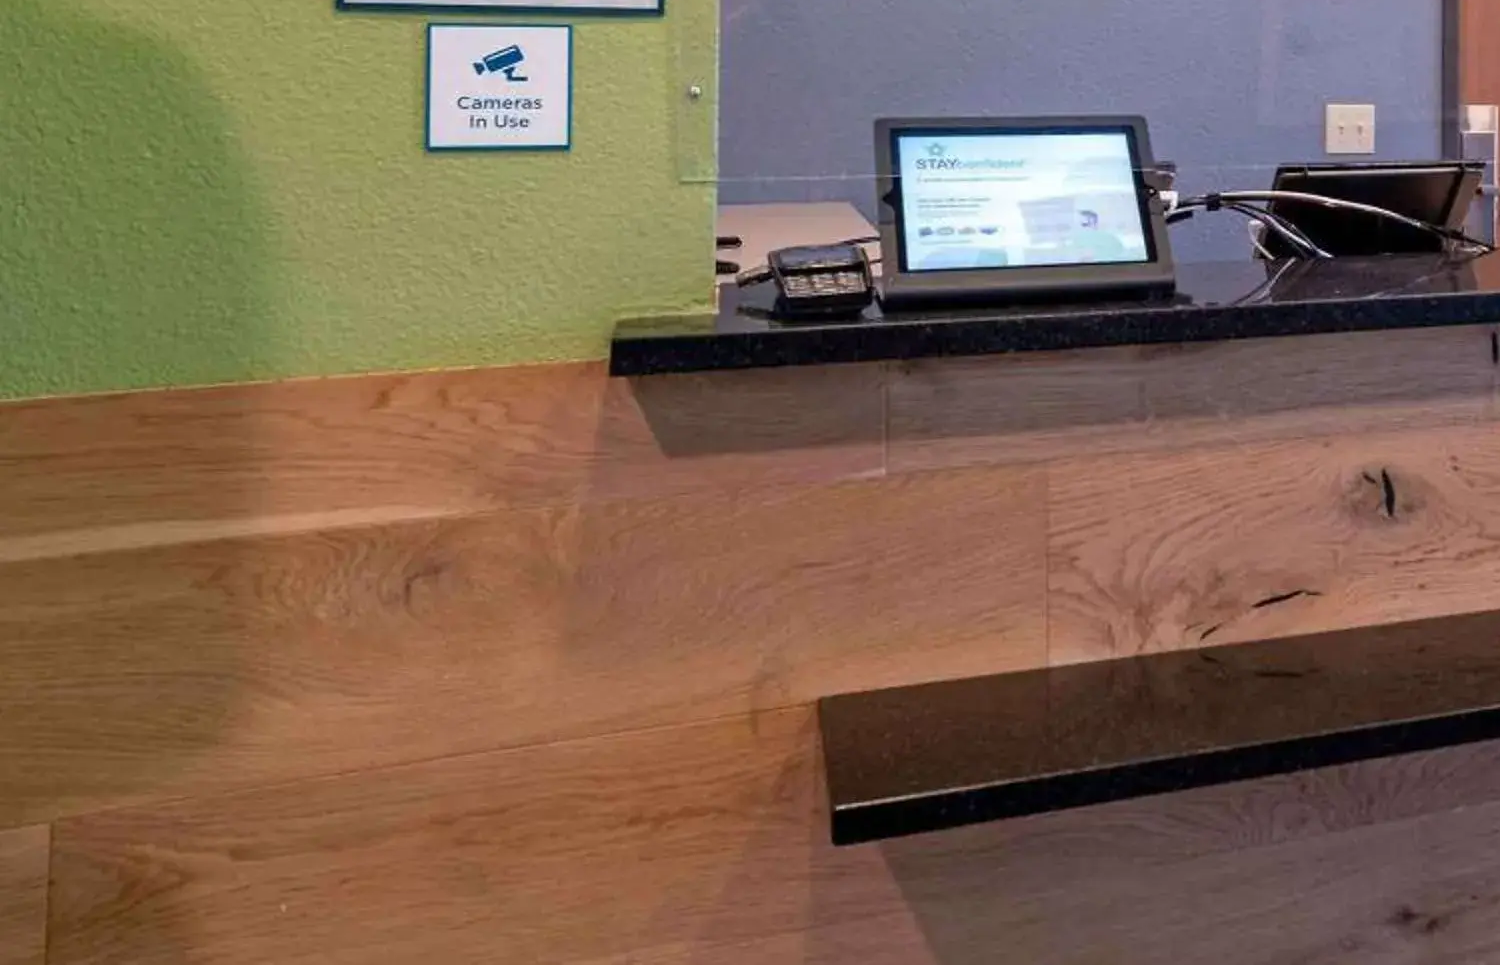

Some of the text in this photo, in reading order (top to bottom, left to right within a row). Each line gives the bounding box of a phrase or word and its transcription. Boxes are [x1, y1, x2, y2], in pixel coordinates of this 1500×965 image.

[457, 96, 543, 110] Cameras
[469, 115, 530, 129] In Use
